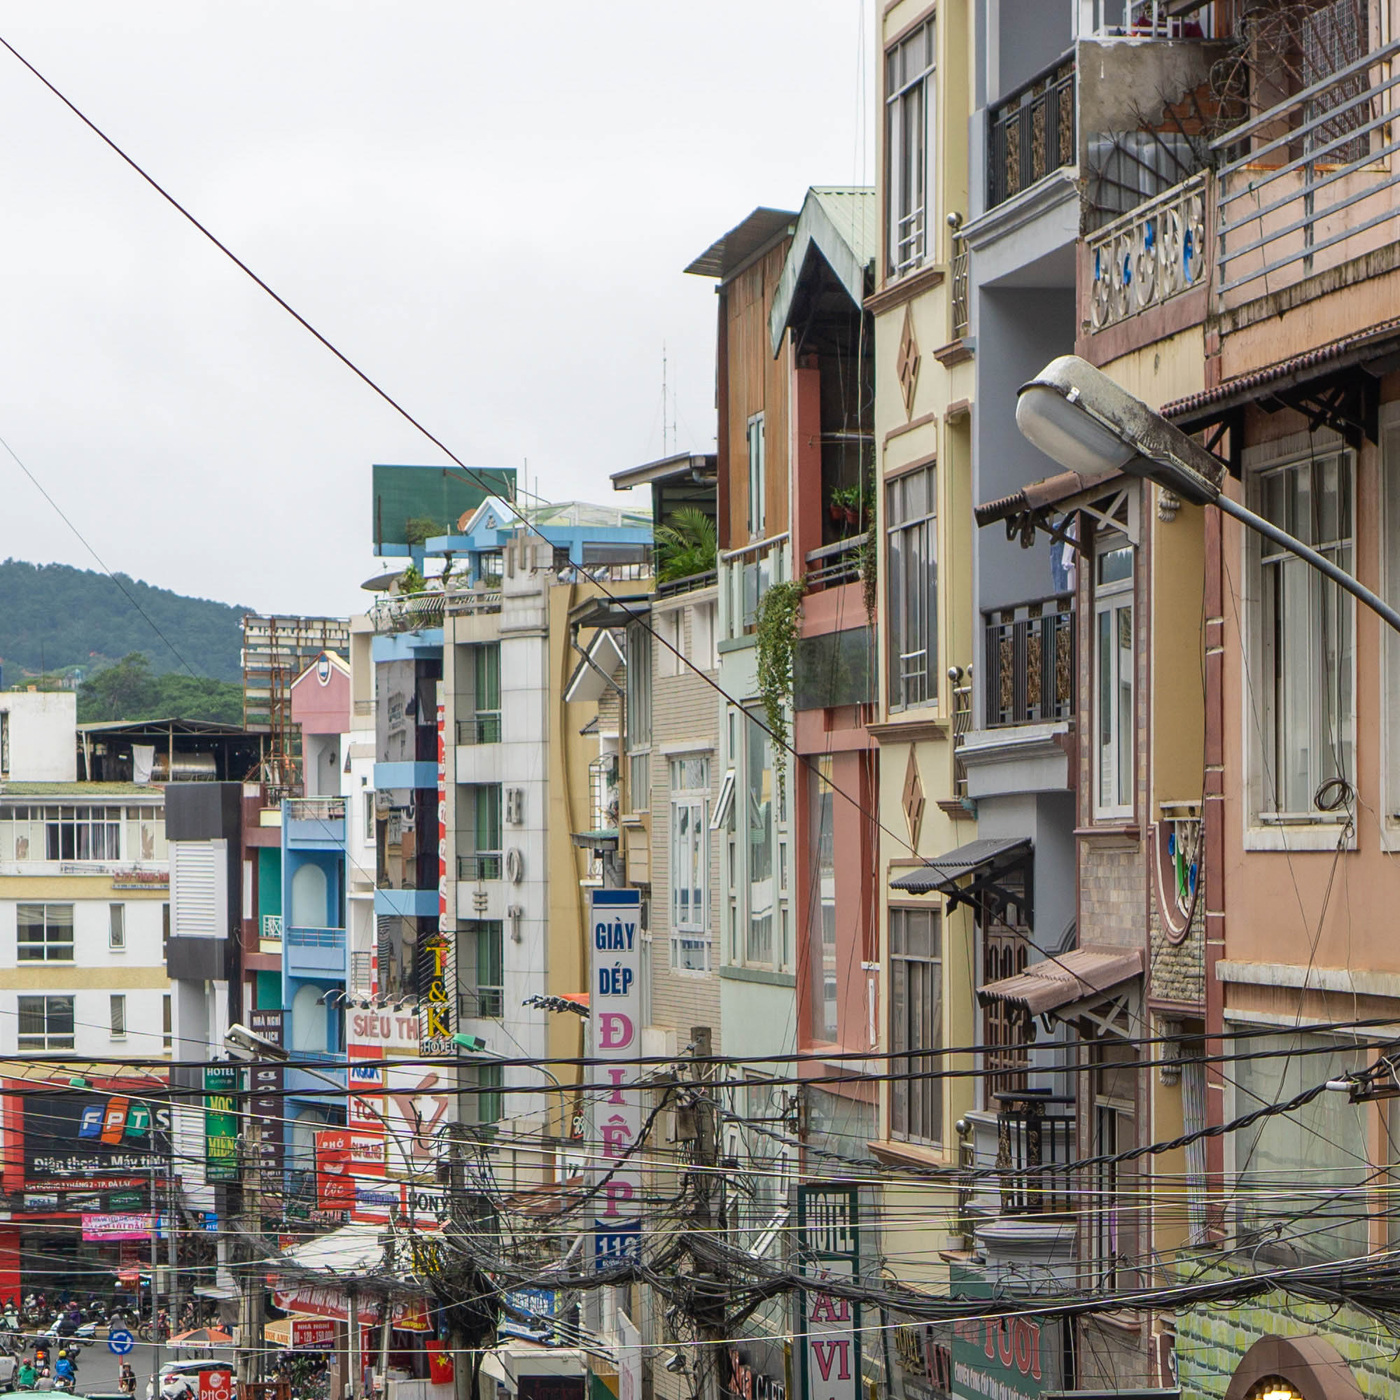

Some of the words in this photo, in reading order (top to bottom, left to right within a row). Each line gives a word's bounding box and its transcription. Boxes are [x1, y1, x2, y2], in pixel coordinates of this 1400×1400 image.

[595, 917, 636, 951] GIÀY
[598, 960, 634, 996] DÉP
[353, 1011, 391, 1039] SIÊU
[206, 1067, 235, 1076] HOTEL
[408, 1192, 449, 1211] SONY
[805, 1191, 854, 1253] HOTEL
[811, 1340, 851, 1381] VI
